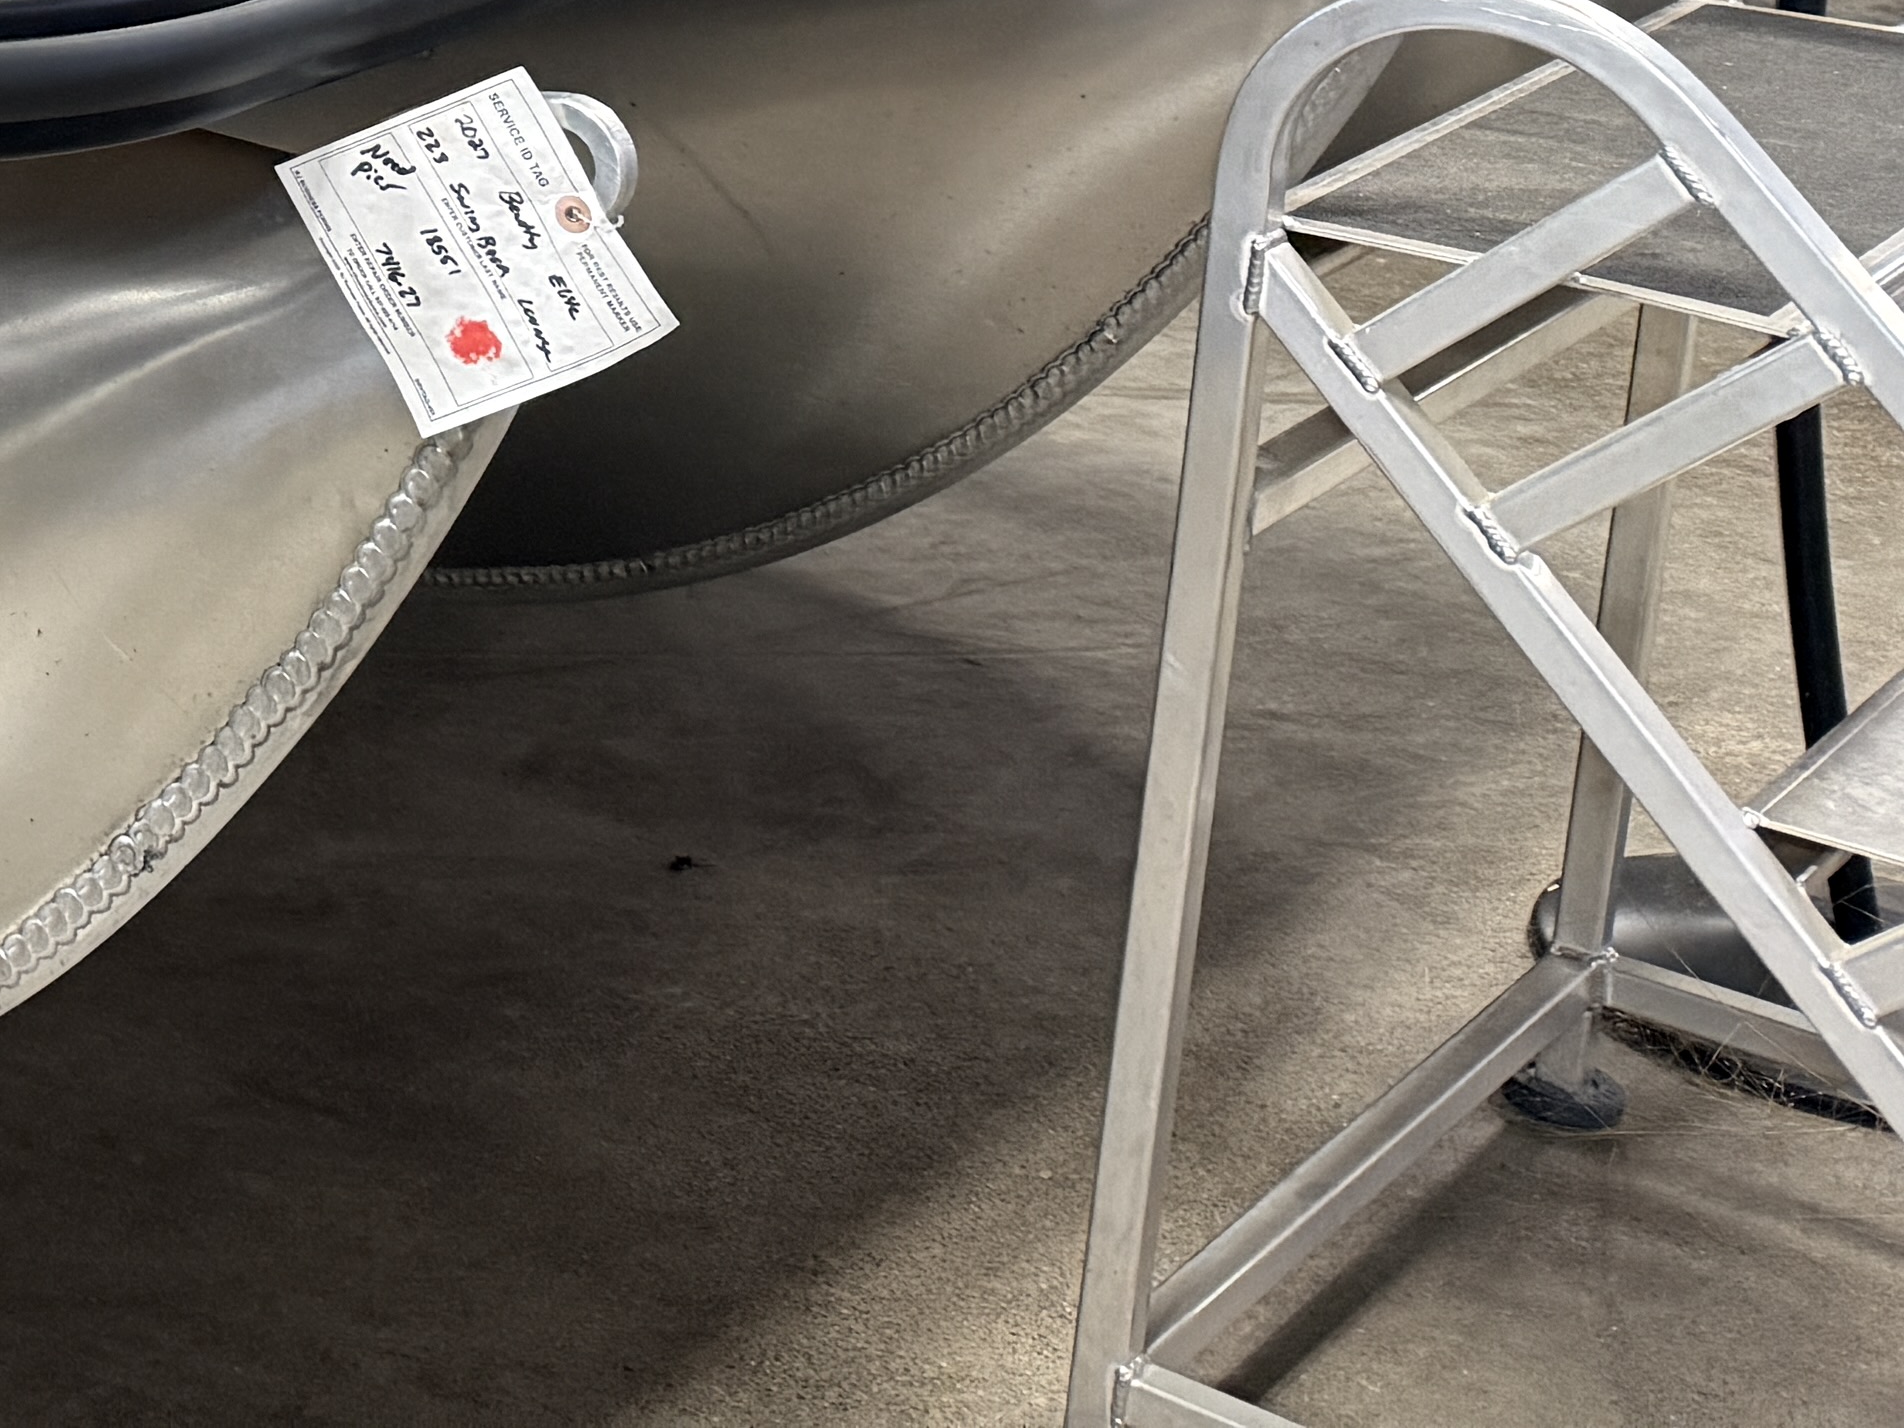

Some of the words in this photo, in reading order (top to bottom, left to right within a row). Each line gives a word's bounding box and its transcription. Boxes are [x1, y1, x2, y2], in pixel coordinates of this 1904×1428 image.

[454, 115, 489, 159] 2027
[488, 92, 525, 146] SERVICE
[520, 147, 533, 160] ID
[529, 162, 549, 187] TAG
